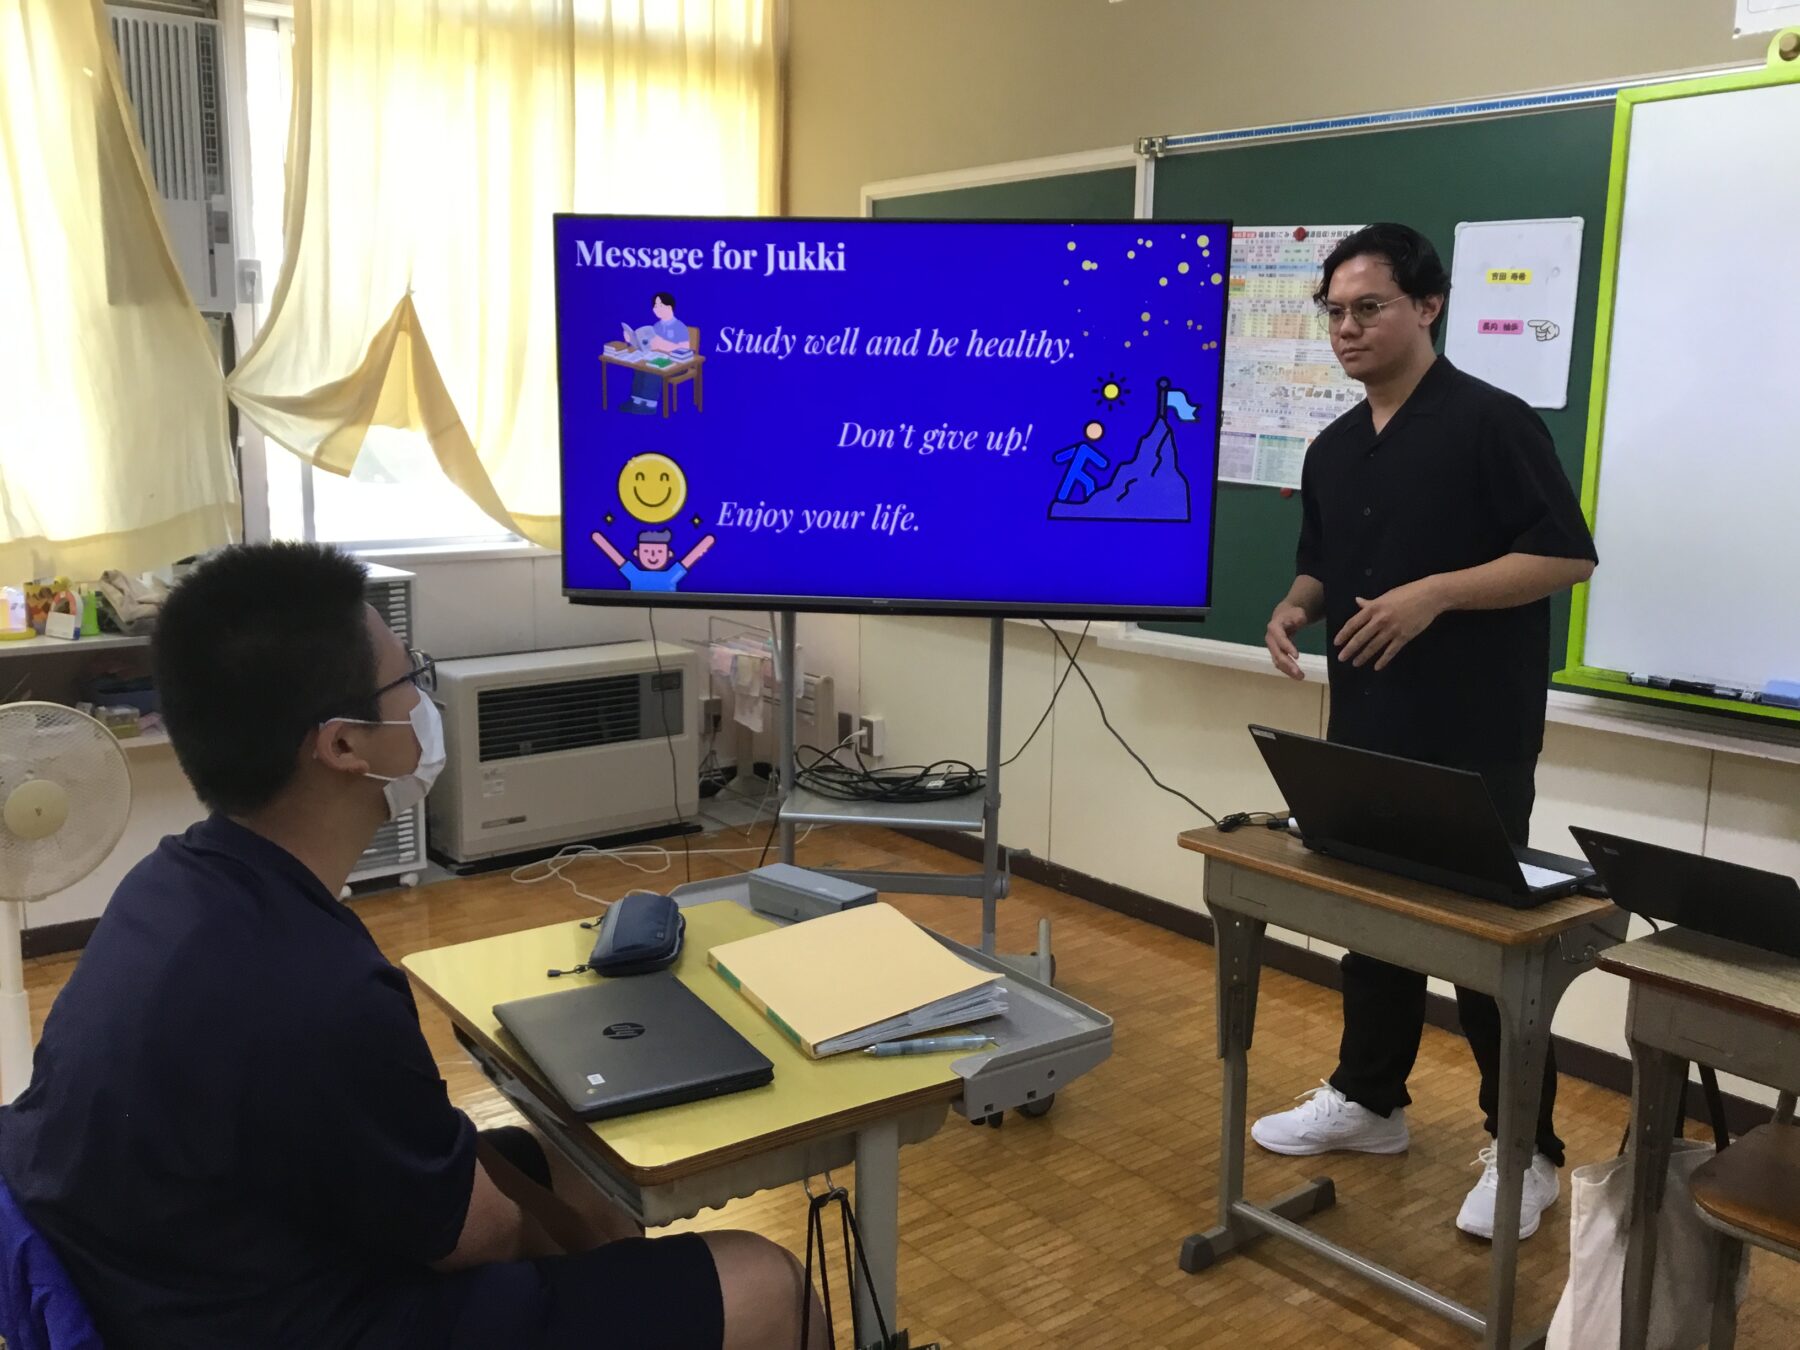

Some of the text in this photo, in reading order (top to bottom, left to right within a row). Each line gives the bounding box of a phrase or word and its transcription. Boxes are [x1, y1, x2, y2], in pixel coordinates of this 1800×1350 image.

[575, 239, 846, 277] Message for Jukki
[715, 325, 1075, 365] Study well and be healthy.
[837, 421, 1034, 457] Don't give up!
[716, 500, 920, 536] Enjoy your life.
